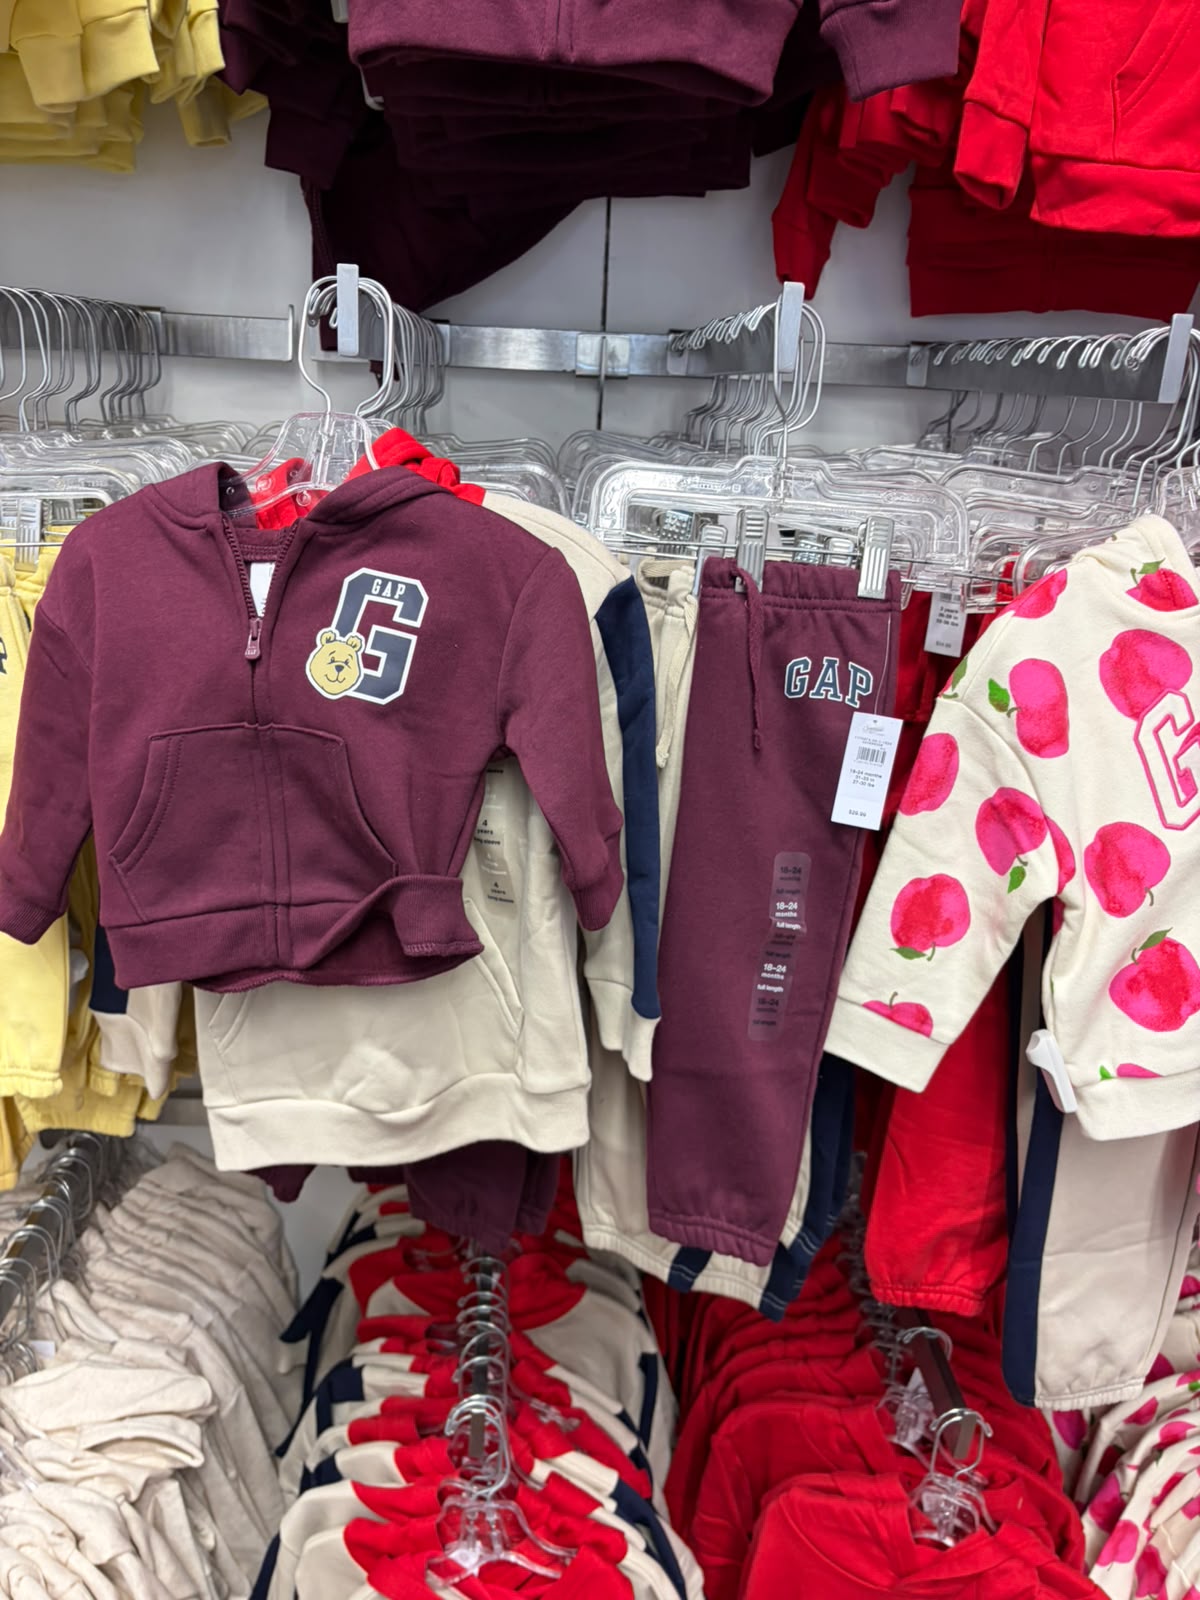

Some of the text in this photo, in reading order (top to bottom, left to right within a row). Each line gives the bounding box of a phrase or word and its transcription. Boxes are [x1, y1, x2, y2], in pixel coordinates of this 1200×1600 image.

[371, 578, 406, 599] GAP
[784, 656, 873, 708] GAP
[1133, 687, 1200, 831] G
[853, 779, 866, 787] 27-30
[482, 819, 488, 827] 4
[483, 838, 500, 846] sleeve
[780, 866, 801, 874] 18-24
[776, 902, 798, 910] 18-24
[785, 923, 802, 931] length
[763, 963, 787, 973] 18-24
[761, 972, 785, 980] months
[766, 985, 784, 993] length
